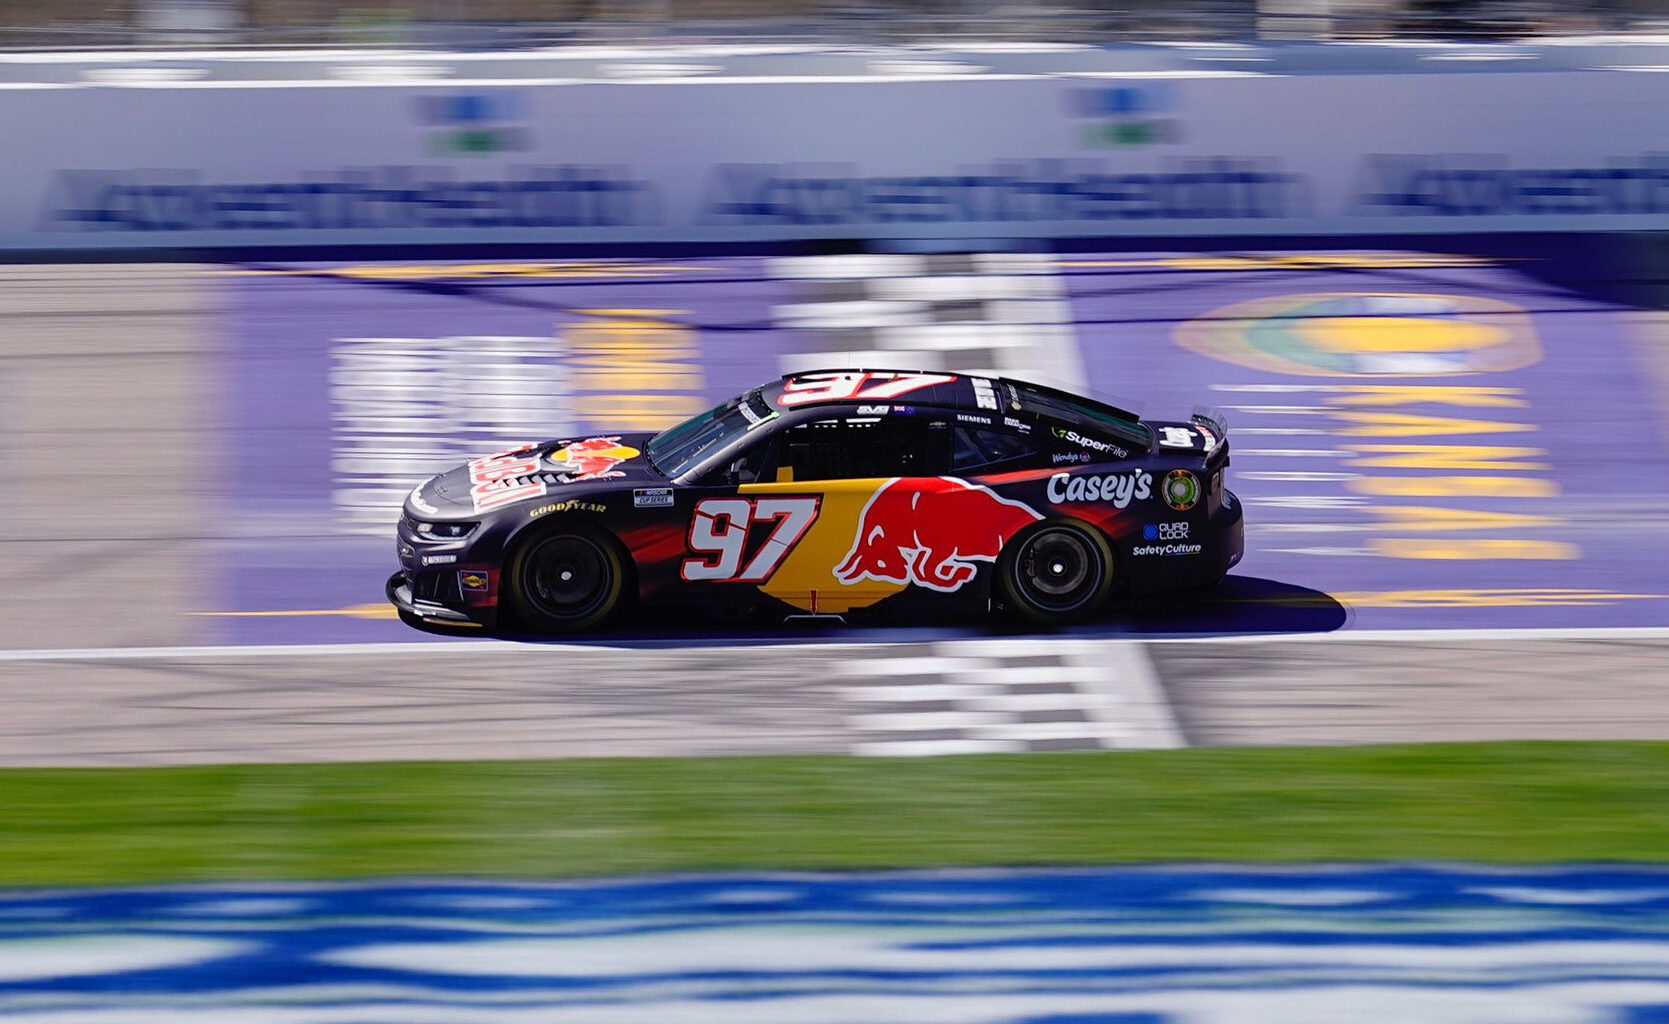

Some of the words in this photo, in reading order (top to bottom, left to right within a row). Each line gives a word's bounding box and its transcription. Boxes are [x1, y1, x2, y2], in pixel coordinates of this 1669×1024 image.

[777, 372, 957, 406] 97
[957, 414, 991, 425] SIEMENS
[1066, 431, 1127, 458] SuperFile
[1047, 468, 1153, 509] Casey's
[529, 500, 607, 517] GOODYEAR
[1159, 521, 1189, 532] QUAD
[681, 497, 820, 583] 97
[1159, 531, 1188, 540] LOCK
[1133, 543, 1202, 556] SafetyCulture
